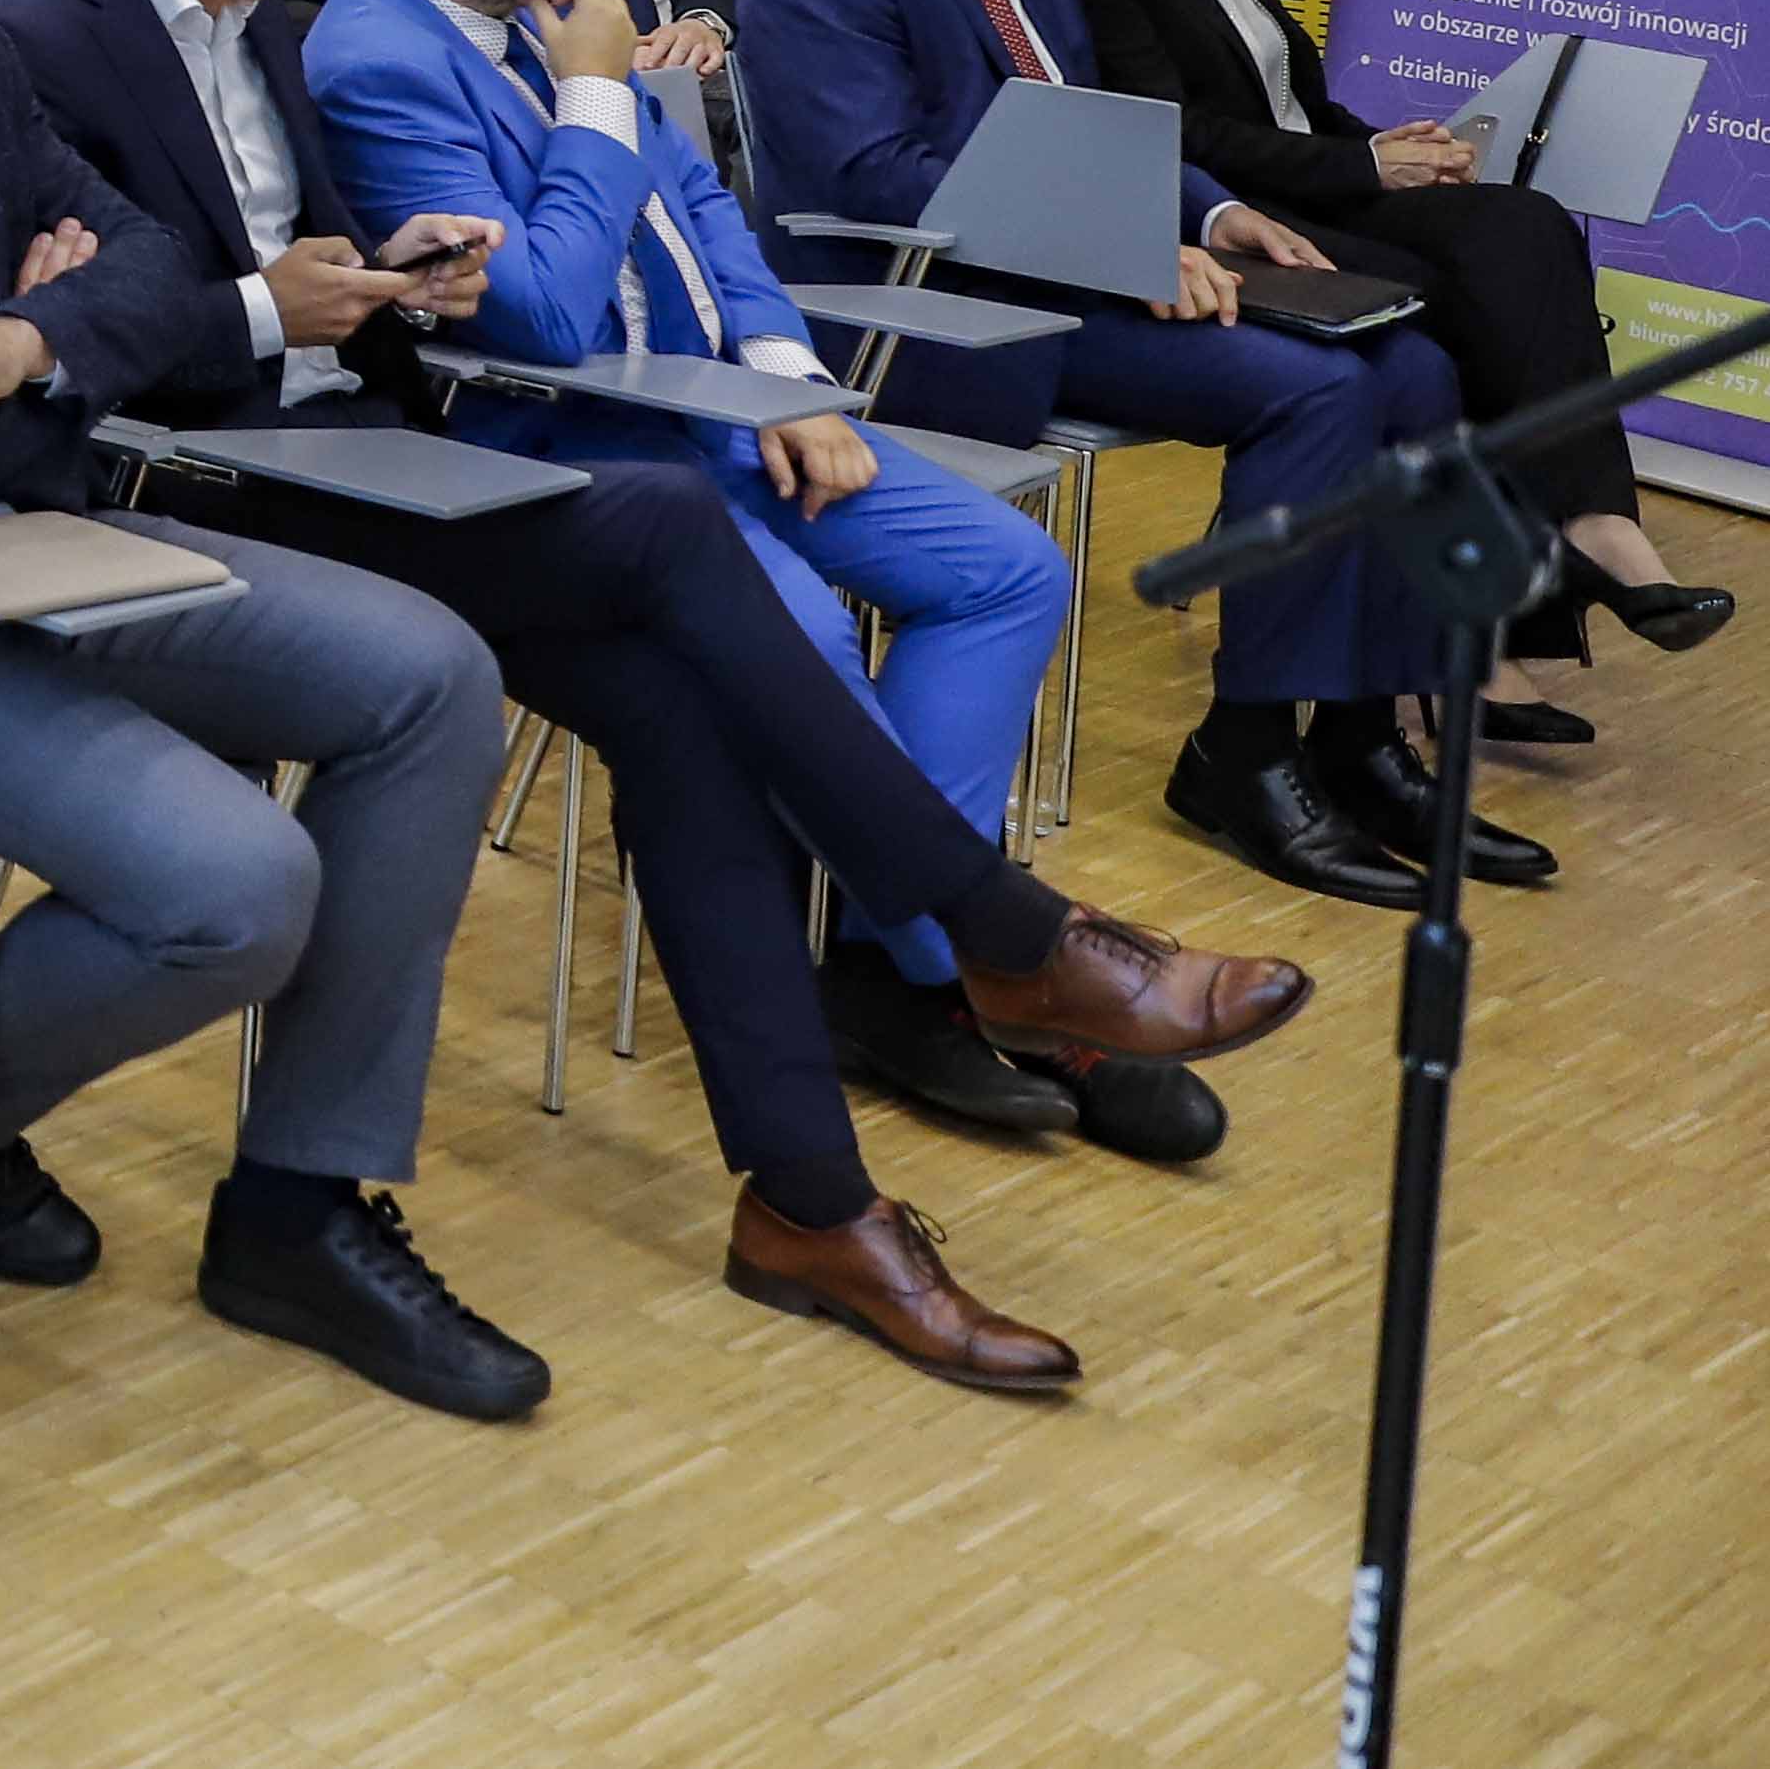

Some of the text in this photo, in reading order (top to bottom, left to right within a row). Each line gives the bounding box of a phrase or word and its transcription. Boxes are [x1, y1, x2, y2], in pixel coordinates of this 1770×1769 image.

[1394, 8, 1414, 27] w
[1420, 8, 1519, 45] obszarze
[1628, 5, 1748, 49] innowacji
[1389, 55, 1490, 92] działanie
